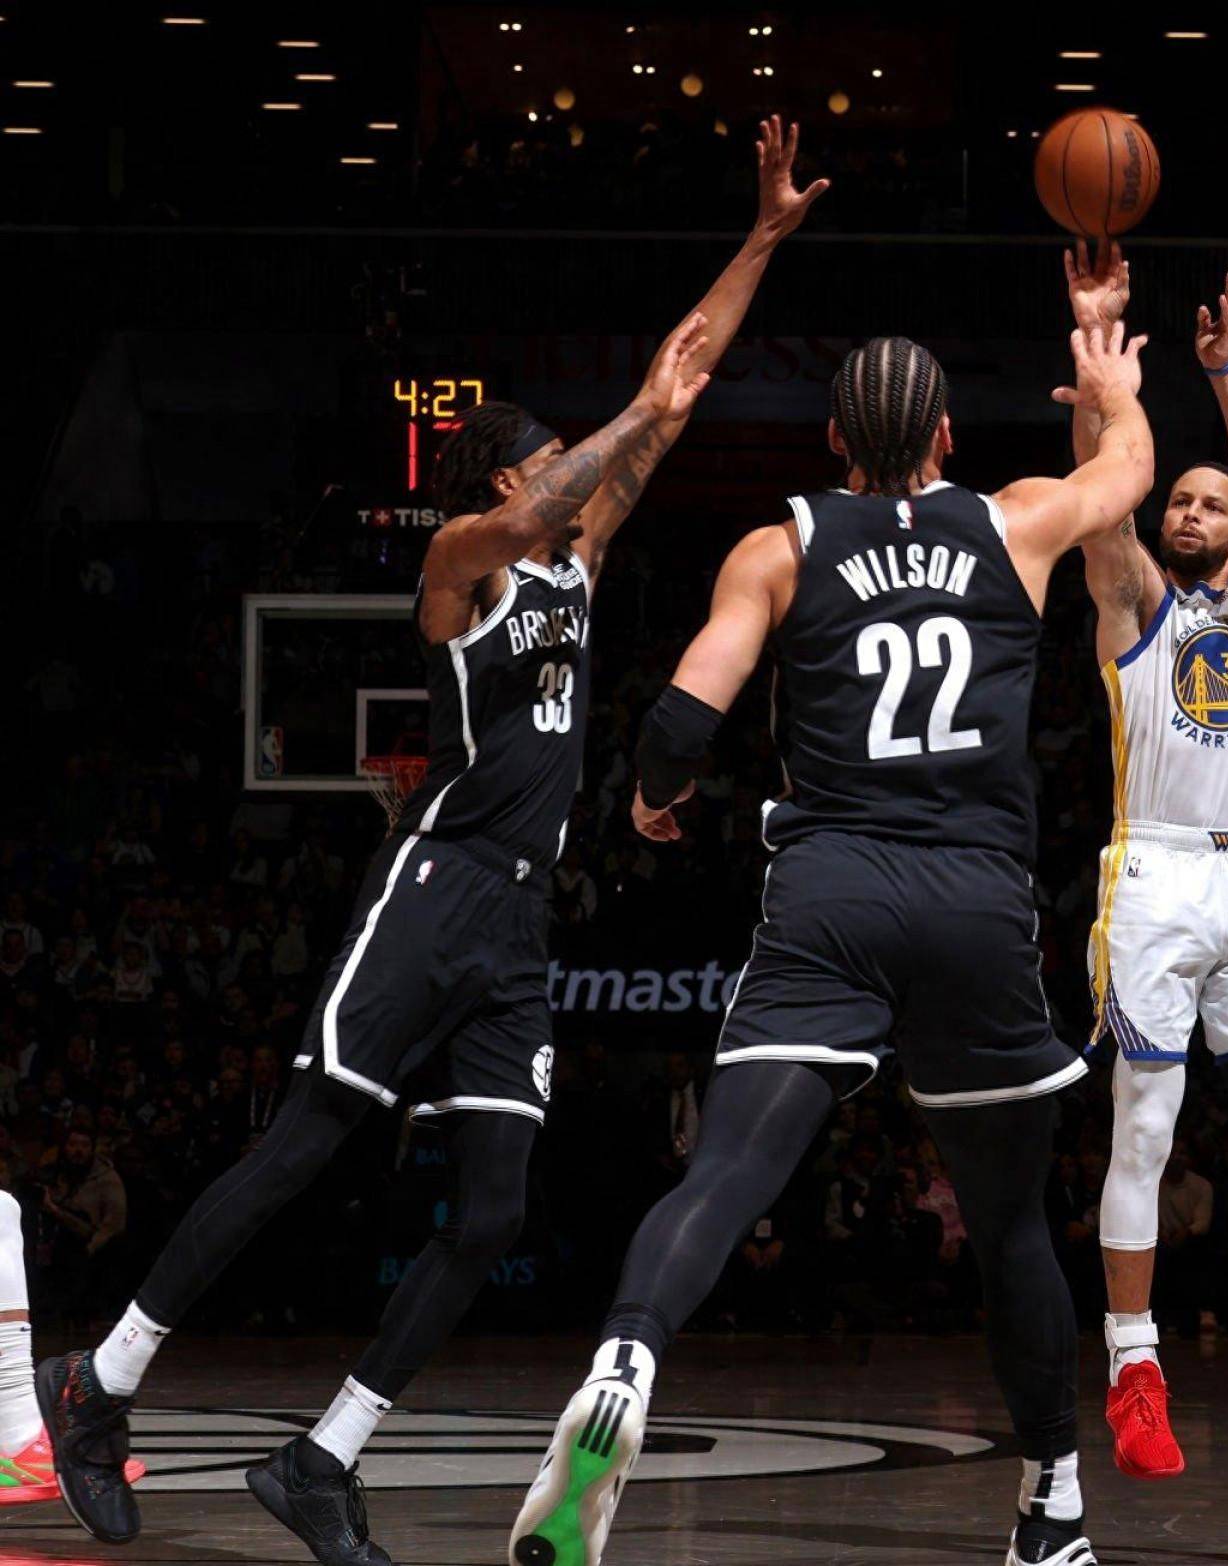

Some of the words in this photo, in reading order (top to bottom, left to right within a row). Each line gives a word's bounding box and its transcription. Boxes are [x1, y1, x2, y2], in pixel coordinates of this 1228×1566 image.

[394, 378, 484, 418] 4:27
[836, 543, 978, 601] WILSON
[533, 661, 574, 734] 33
[856, 616, 983, 760] 22
